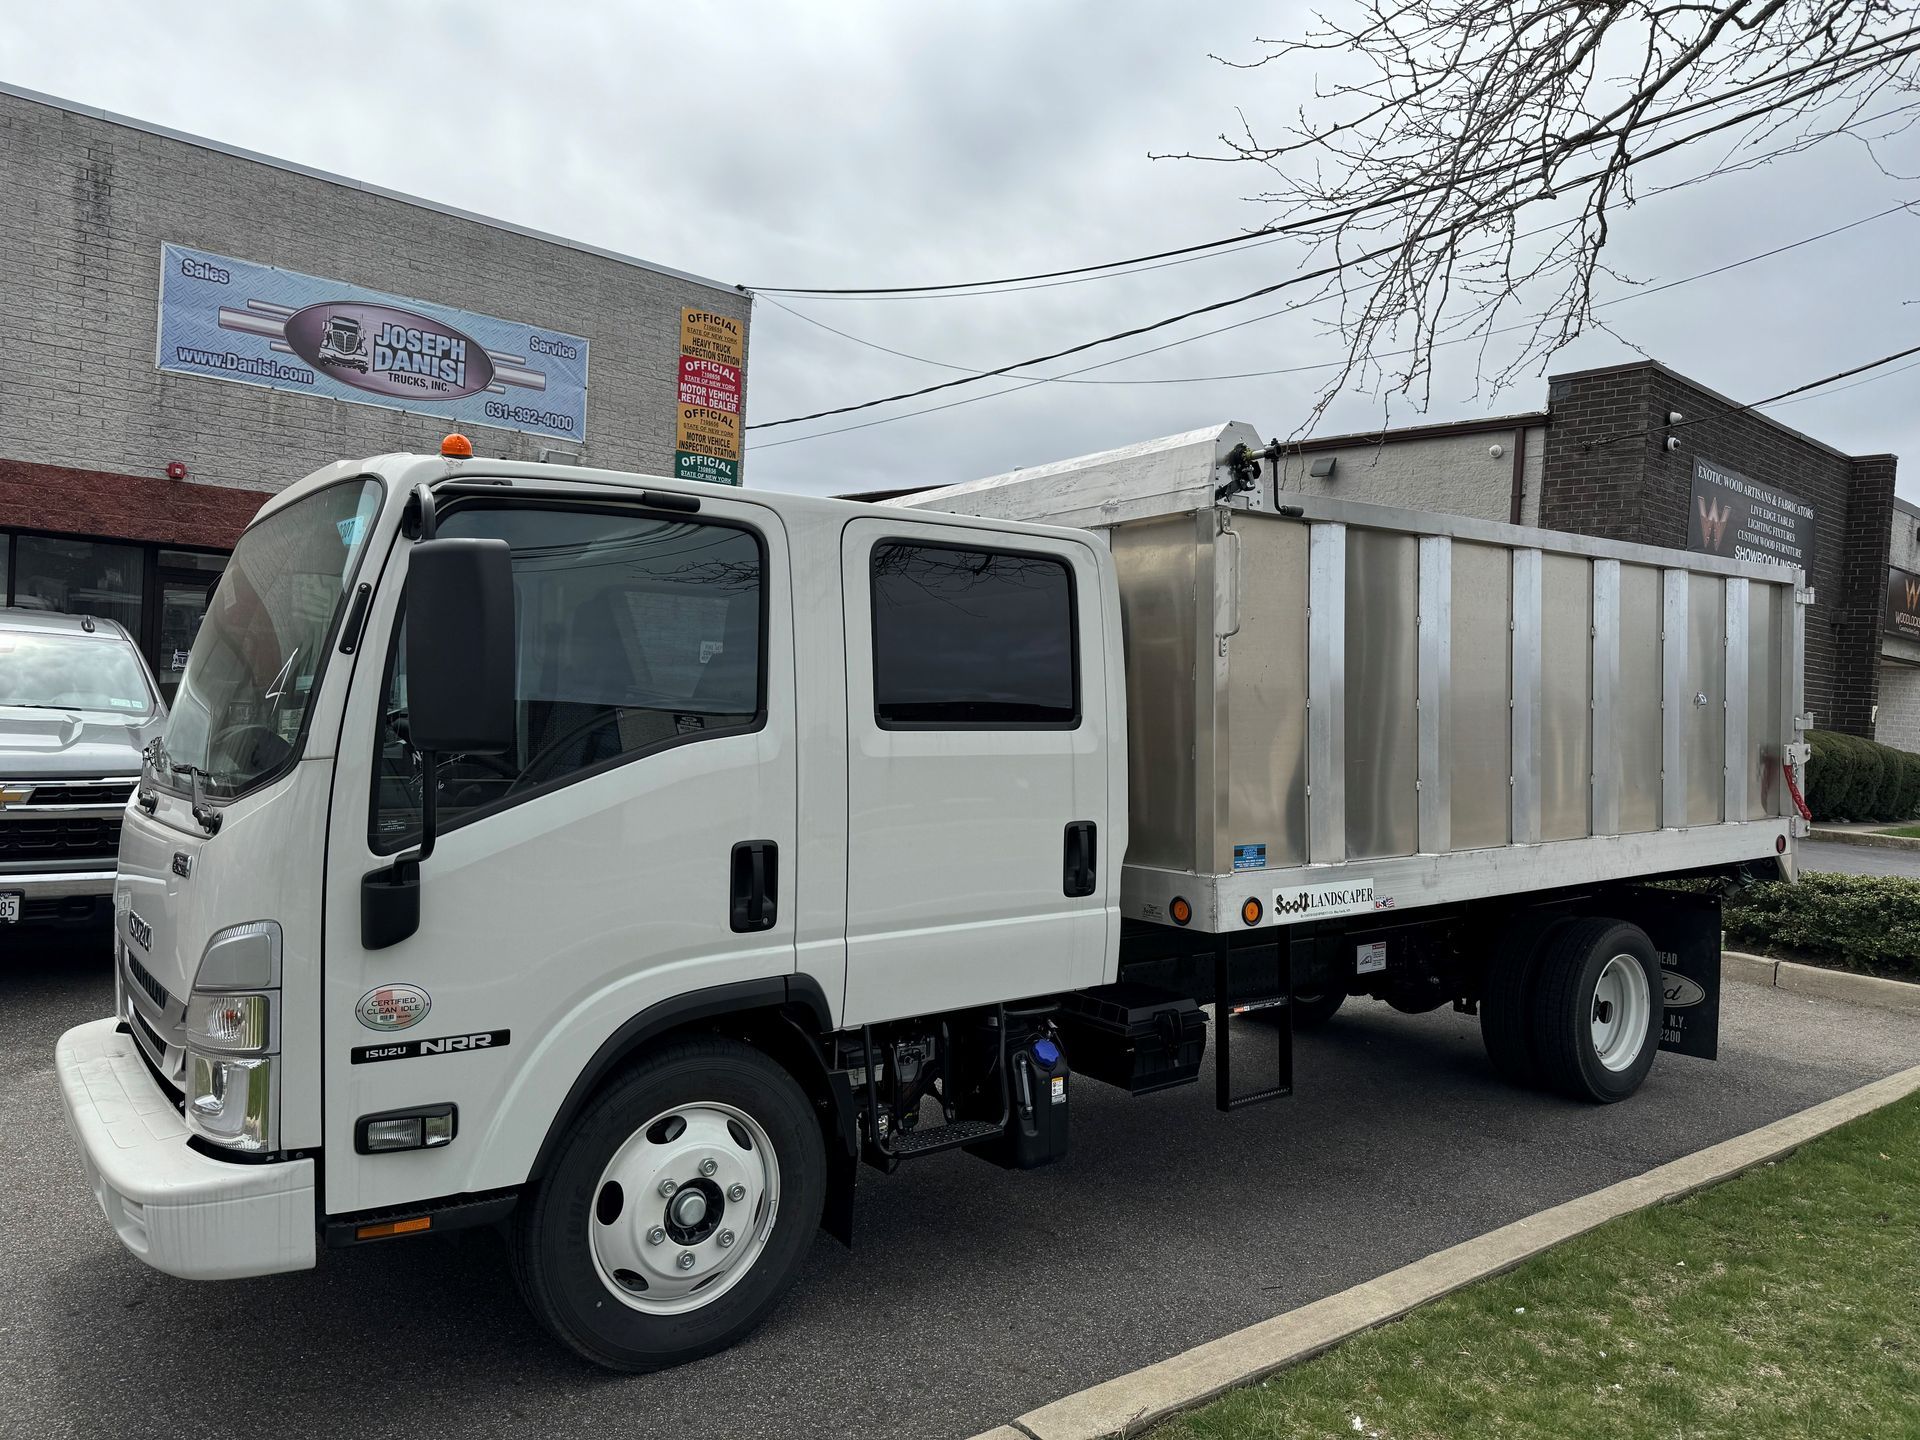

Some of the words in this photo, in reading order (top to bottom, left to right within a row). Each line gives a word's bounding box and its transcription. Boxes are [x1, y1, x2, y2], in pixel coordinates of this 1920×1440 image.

[182, 258, 229, 284] Sales
[688, 313, 737, 335] OFFICIAL
[375, 322, 466, 361] JOSEPH
[687, 327, 702, 335] STATE
[724, 336, 737, 344] YORK
[692, 337, 711, 349] HEAVY
[713, 342, 731, 354] TRUCK
[530, 336, 576, 359] Service
[682, 344, 716, 360] INSPECTION
[717, 353, 740, 366] STATION
[177, 347, 314, 384] www.Danisi.com
[373, 346, 465, 389] DANISI
[685, 361, 735, 382] OFFICIAL
[388, 372, 428, 389] TRUCKS,
[431, 380, 450, 392] INC.
[680, 382, 706, 396] MOTOR
[708, 389, 738, 403] VEHICLE
[684, 375, 700, 383] STATE
[722, 383, 736, 391] YORK
[681, 393, 707, 406] RETAIL
[709, 399, 736, 412] DEALER
[485, 401, 573, 431] 631-392-4000
[684, 409, 734, 429] OFFICIAL
[684, 423, 698, 431] STATE
[721, 430, 734, 438] YORK
[687, 432, 706, 443] MOTOR
[708, 436, 731, 448] VEHICLE
[679, 440, 713, 455] INSPECTION
[714, 447, 737, 459] STATION
[682, 456, 732, 475] OFFICIAL
[718, 477, 732, 485] YORK
[1698, 466, 1722, 485] EXOTIC
[1723, 476, 1743, 493] WOOD
[1743, 485, 1771, 503] ARTISANS
[1771, 495, 1777, 506] &
[1777, 497, 1814, 520] FABRICATORS
[1751, 505, 1762, 517] LIVE
[1763, 509, 1777, 522] EDGE
[1777, 514, 1795, 528] TABLES
[1748, 518, 1772, 535] LIGHTING
[1773, 528, 1795, 542] FIXTURES
[1738, 530, 1759, 545] CUSTOM
[1760, 536, 1775, 550] WOOD
[1776, 542, 1802, 558] FURNITURE
[265, 647, 298, 717] 4
[1311, 887, 1374, 908] LANDSCAPER
[367, 1007, 397, 1015] CLEAN
[401, 1004, 420, 1012] IDLE
[371, 997, 416, 1007] CERTIFIED
[366, 1046, 406, 1059] ISUZU
[420, 1034, 492, 1055] NRR
